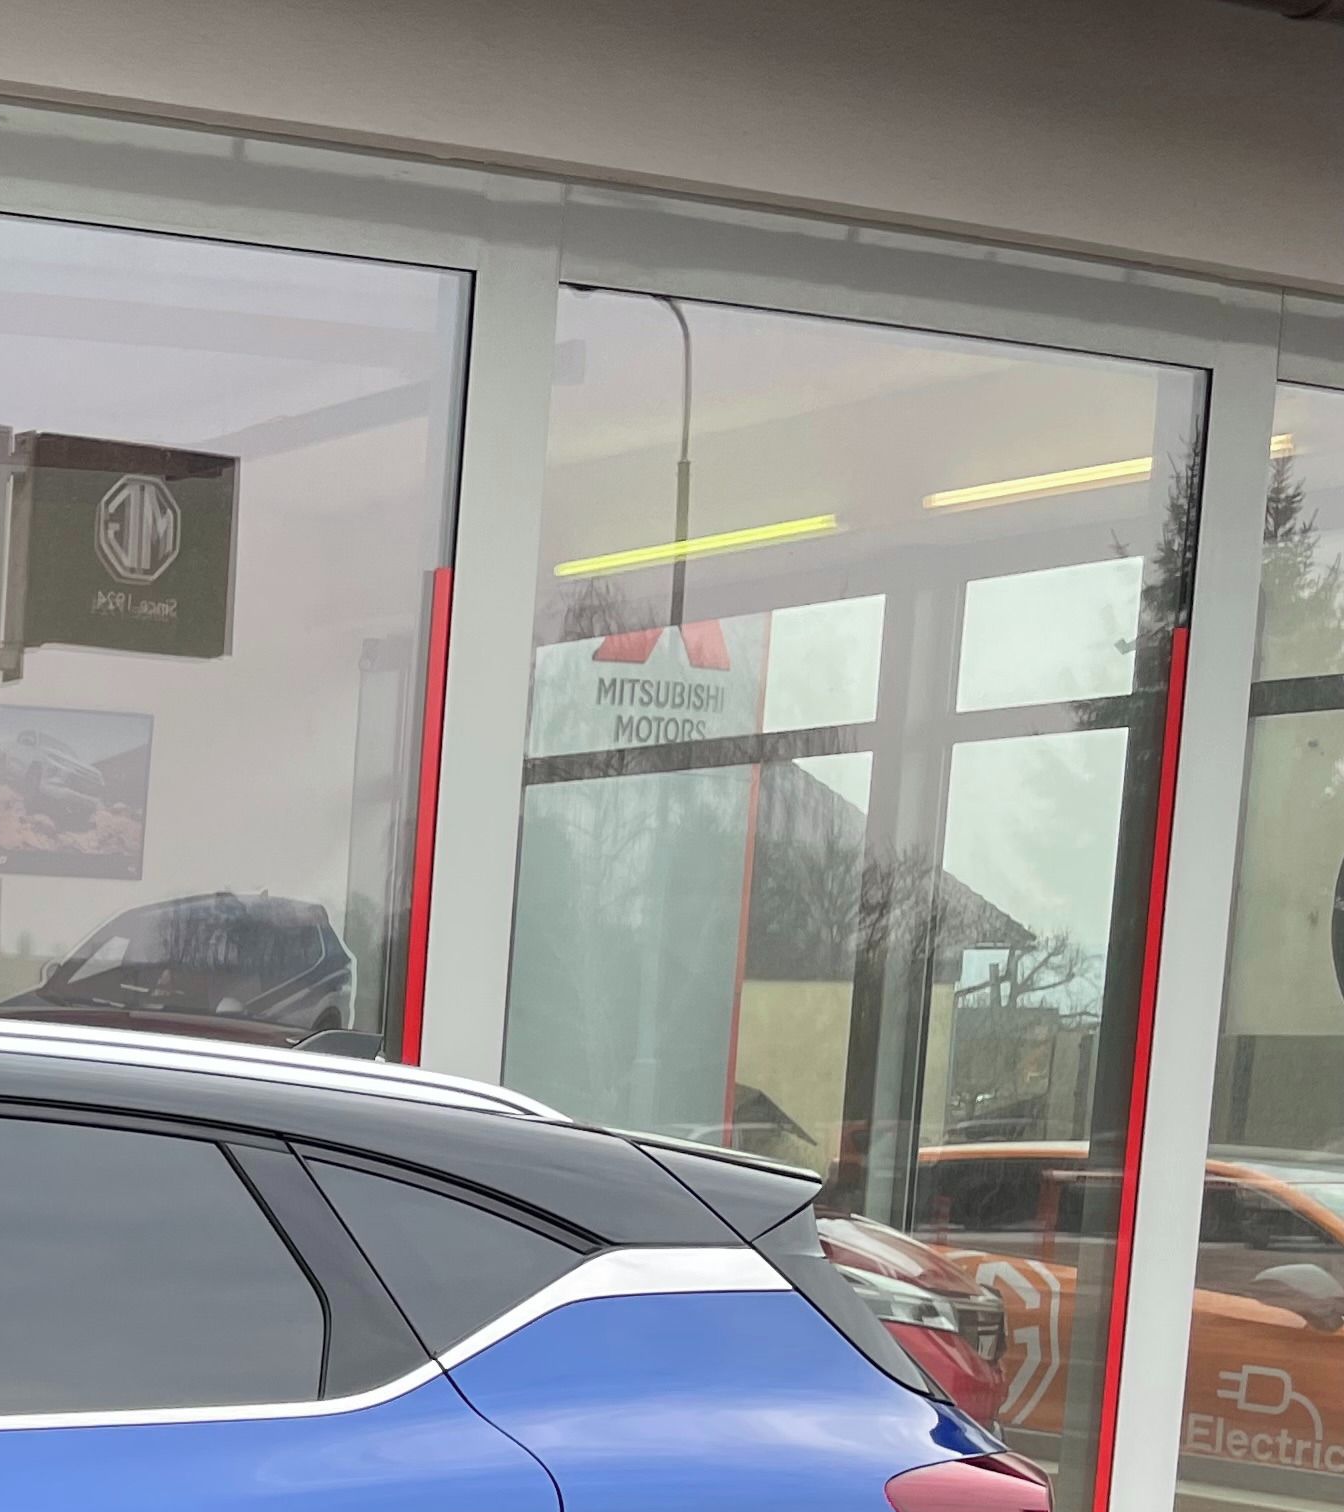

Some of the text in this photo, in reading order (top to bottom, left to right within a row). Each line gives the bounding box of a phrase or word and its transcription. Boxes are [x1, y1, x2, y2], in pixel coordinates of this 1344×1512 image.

[595, 677, 725, 713] MITSUBISHI
[614, 714, 707, 744] MOTORS
[1185, 1412, 1344, 1473] Electric
